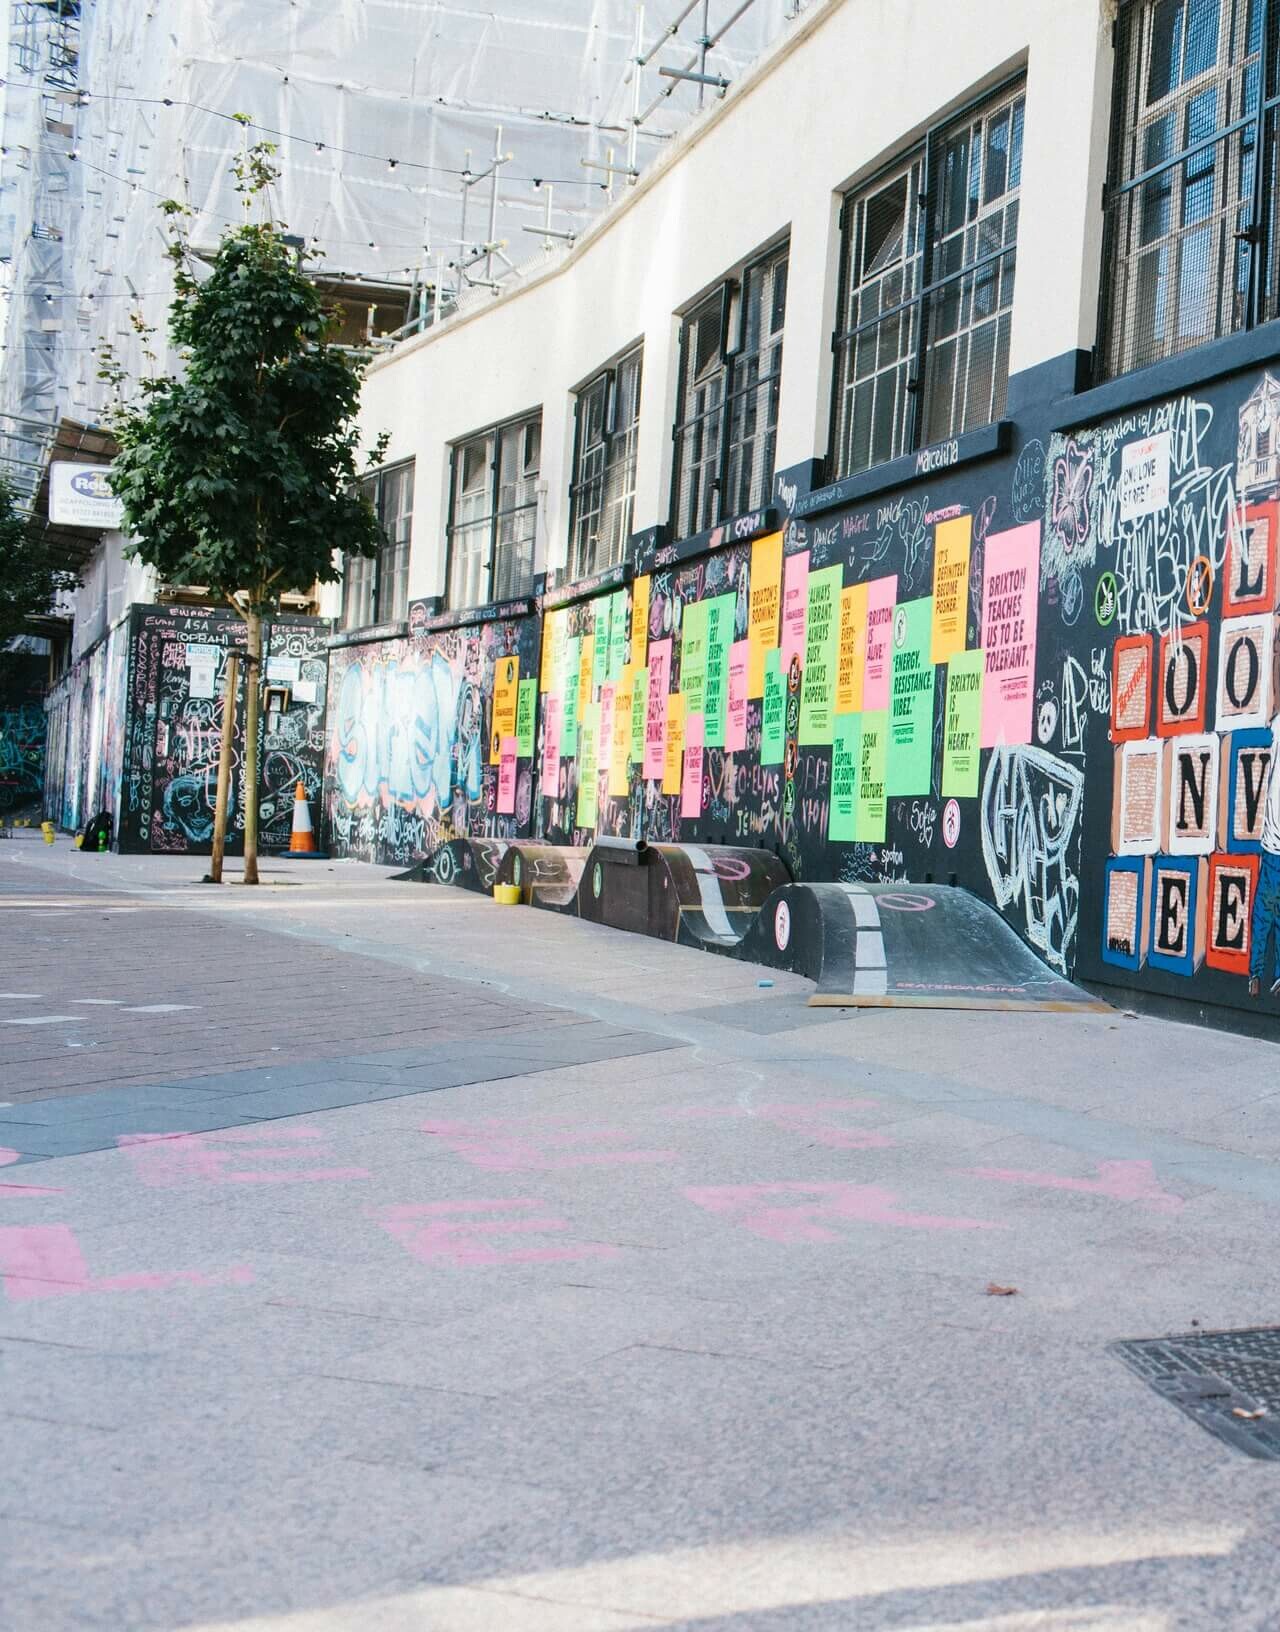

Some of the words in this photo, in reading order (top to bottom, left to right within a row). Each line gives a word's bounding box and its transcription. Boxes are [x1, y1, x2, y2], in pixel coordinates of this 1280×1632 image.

[988, 595, 1022, 623] TEACHES
[807, 623, 829, 644] ALWAYS
[868, 628, 874, 645] IS
[986, 625, 997, 648] US
[999, 623, 1010, 646] TO
[1012, 619, 1025, 643] BE
[894, 671, 933, 695] RESISTANCE.
[949, 695, 957, 713] IS
[948, 714, 960, 732] MY
[862, 749, 871, 766] UP
[862, 766, 871, 782] THE
